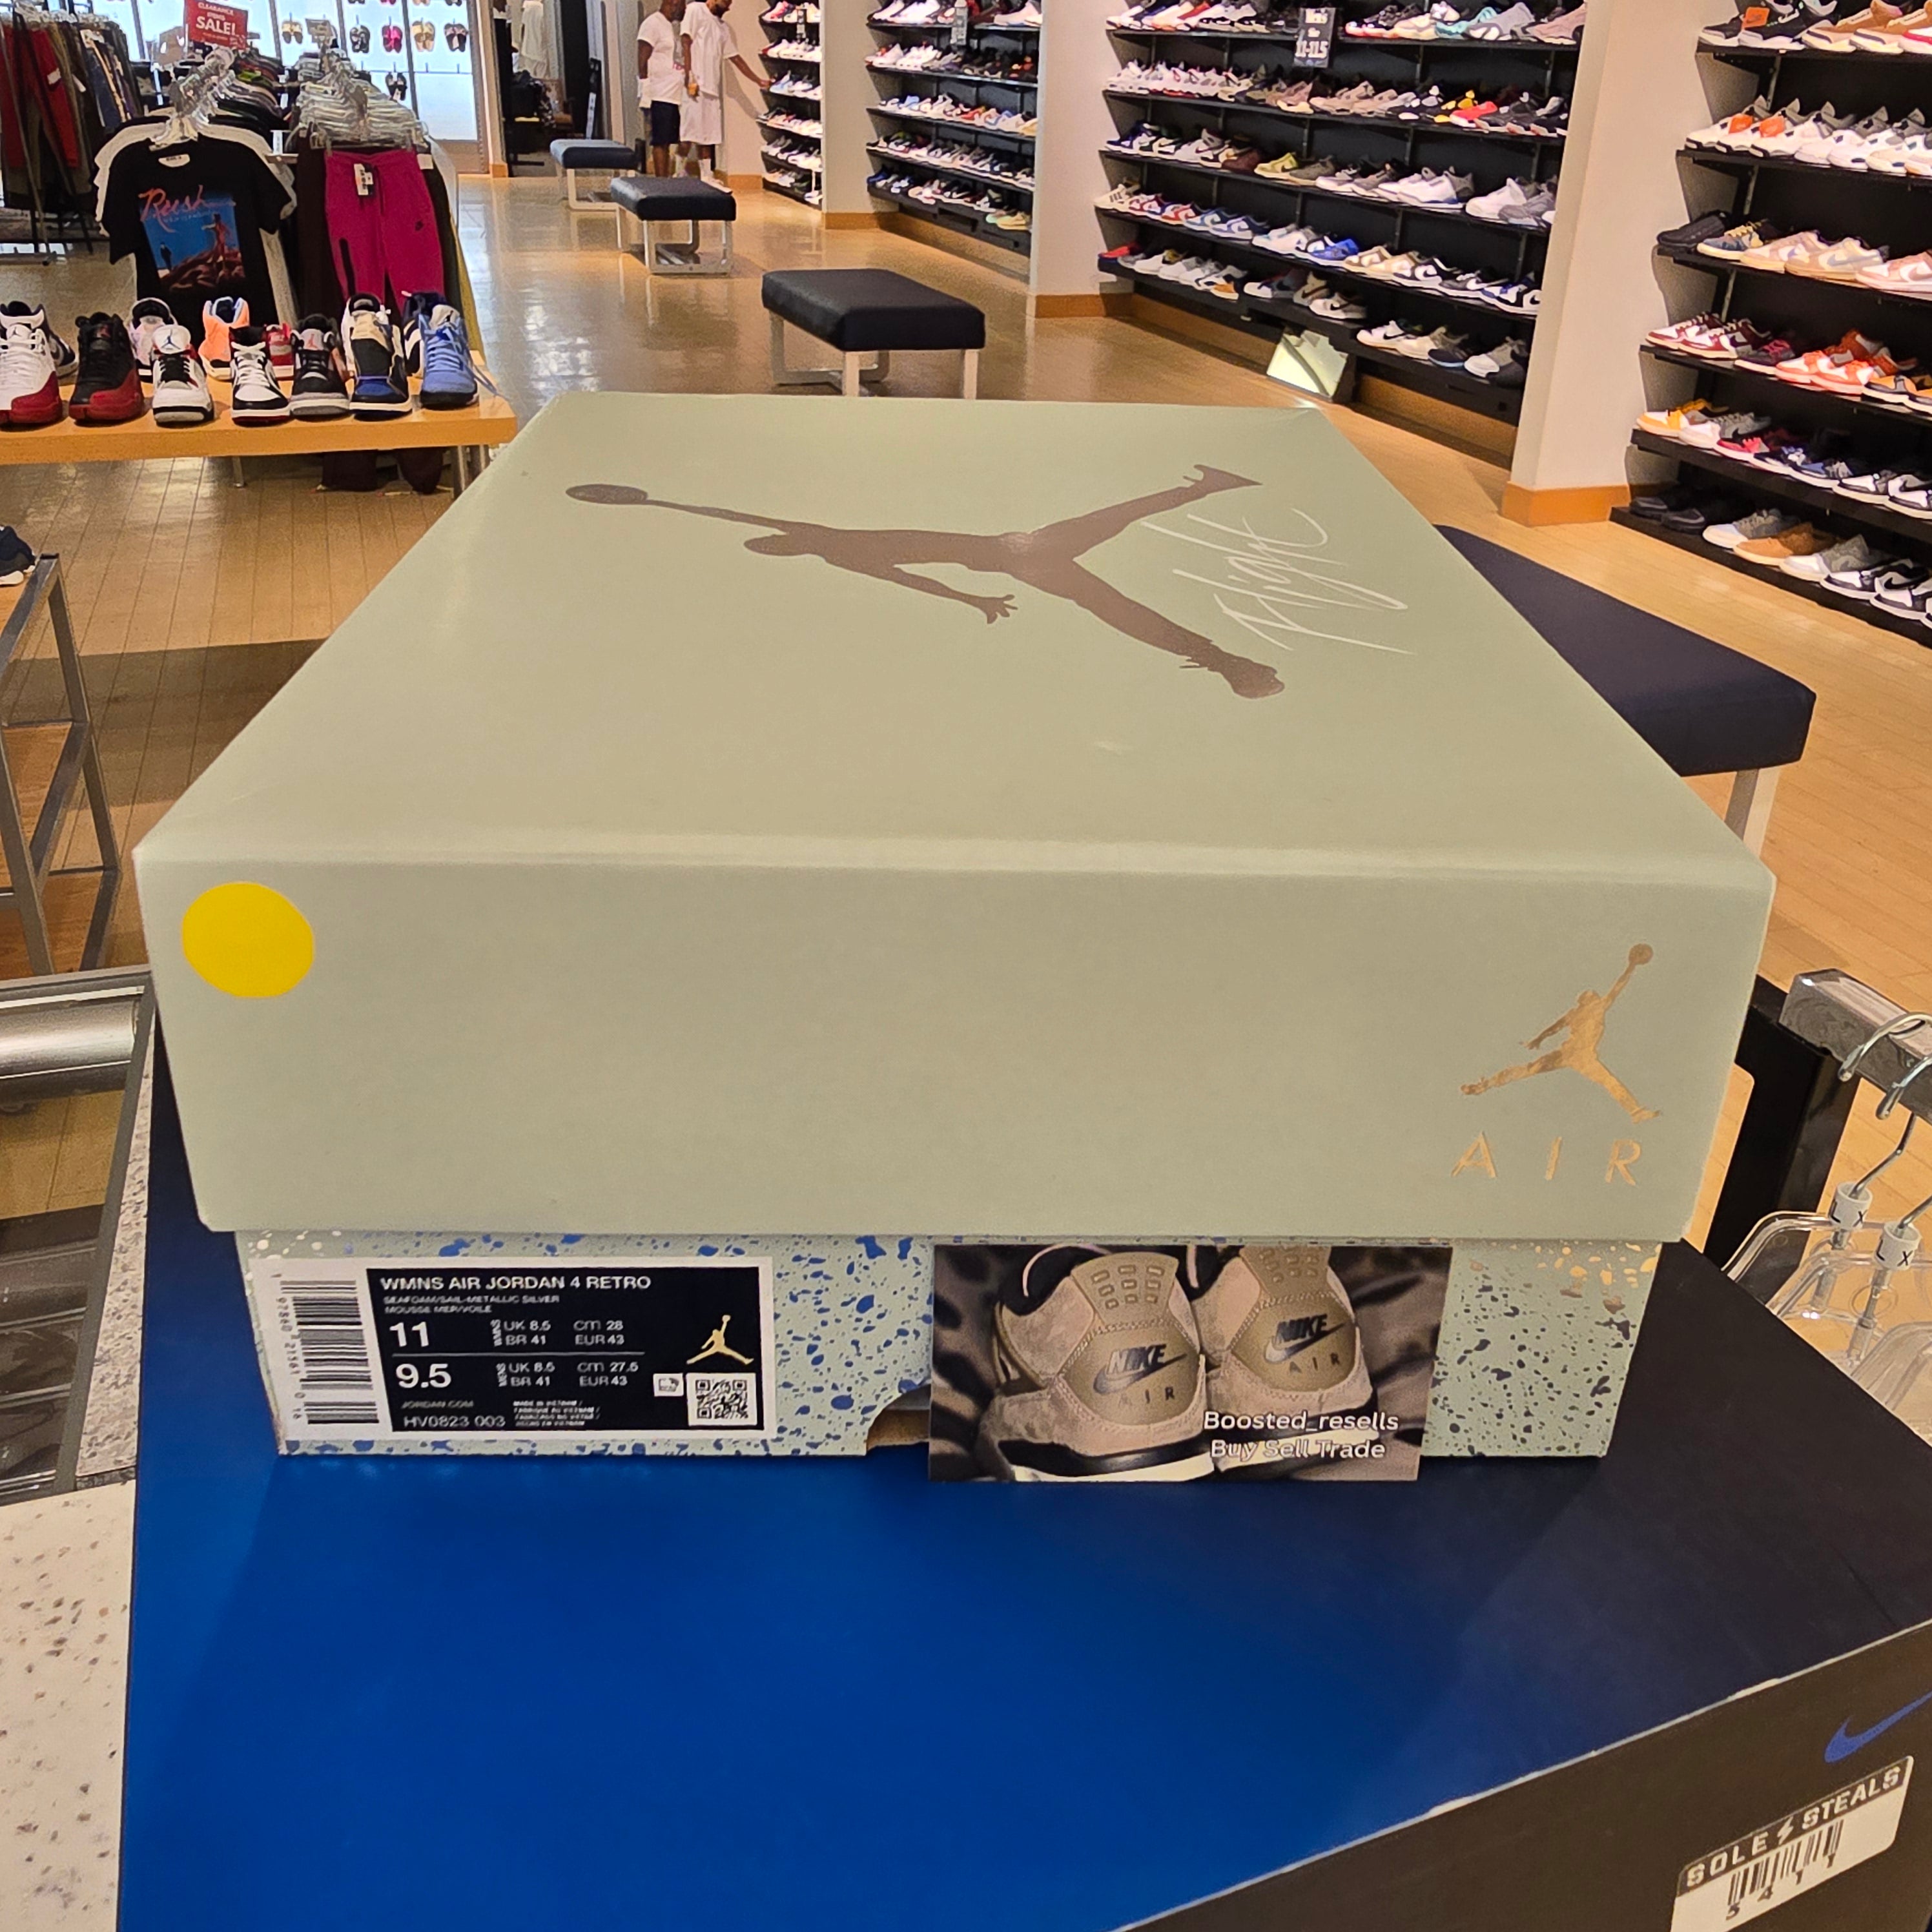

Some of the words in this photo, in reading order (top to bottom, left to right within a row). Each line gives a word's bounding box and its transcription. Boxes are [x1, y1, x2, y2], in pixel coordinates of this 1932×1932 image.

[196, 15, 236, 36] SALE!
[1451, 1132, 1641, 1186] AIR
[380, 1277, 444, 1290] WMNS
[449, 1277, 481, 1290] AIR
[485, 1276, 565, 1290] JORDAN
[570, 1276, 581, 1289] 4
[586, 1276, 652, 1289] RETRO
[522, 1294, 560, 1304] SILVER
[504, 1320, 526, 1331] UK
[606, 1320, 624, 1331] 28
[1274, 1313, 1328, 1345] NIKE
[389, 1321, 429, 1347] 11
[505, 1334, 528, 1346] BR
[530, 1334, 546, 1344] 41
[575, 1334, 606, 1344] EUR
[607, 1334, 625, 1344] 43
[1107, 1344, 1167, 1375] NIKE
[508, 1362, 530, 1373] UK
[395, 1363, 451, 1388] 9.5
[510, 1377, 532, 1386] BR
[535, 1376, 550, 1386] 41
[579, 1376, 609, 1386] EUR
[611, 1375, 628, 1386] 43
[404, 1415, 470, 1427] HV0823
[474, 1415, 506, 1427] 003
[1204, 1410, 1399, 1431] Boosted_resells
[1211, 1439, 1257, 1462] Buy
[1264, 1439, 1309, 1458] Sell
[1315, 1439, 1386, 1458] Trade
[1685, 1831, 1769, 1887] SOLE
[1802, 1765, 1901, 1830] STEALS
